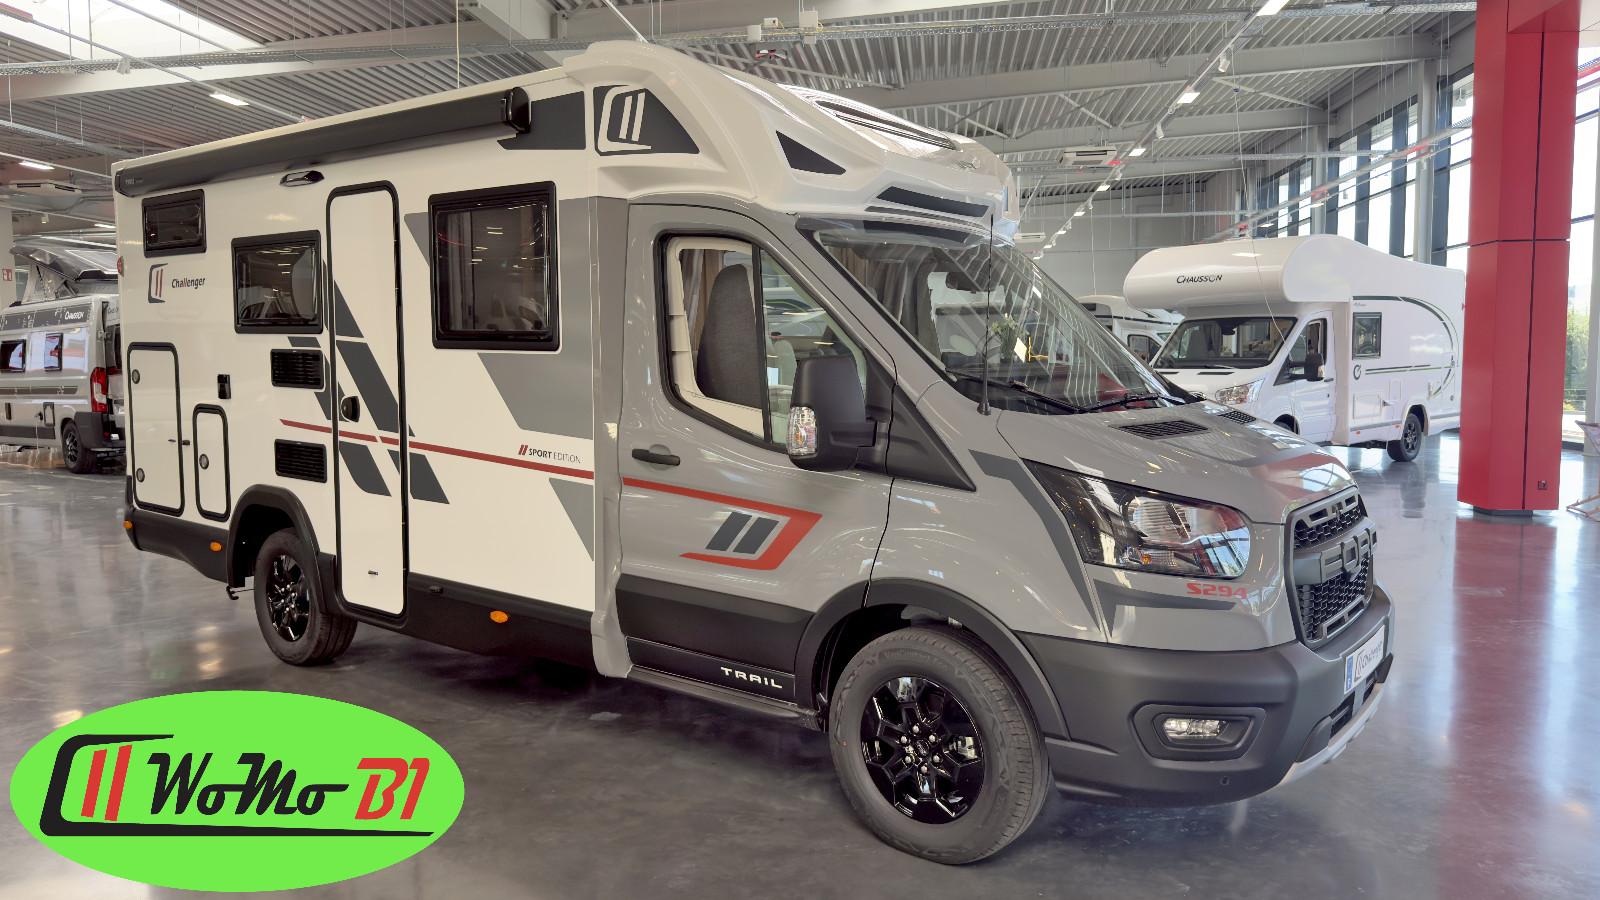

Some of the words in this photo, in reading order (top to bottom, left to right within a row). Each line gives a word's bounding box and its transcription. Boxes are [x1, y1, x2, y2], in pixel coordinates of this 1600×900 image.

[171, 277, 206, 290] Challenger
[1176, 274, 1223, 284] CHAUSSON
[528, 448, 552, 459] SPORT
[553, 452, 582, 464] EDITION
[1186, 582, 1248, 600] S294
[720, 666, 783, 689] TRAIL
